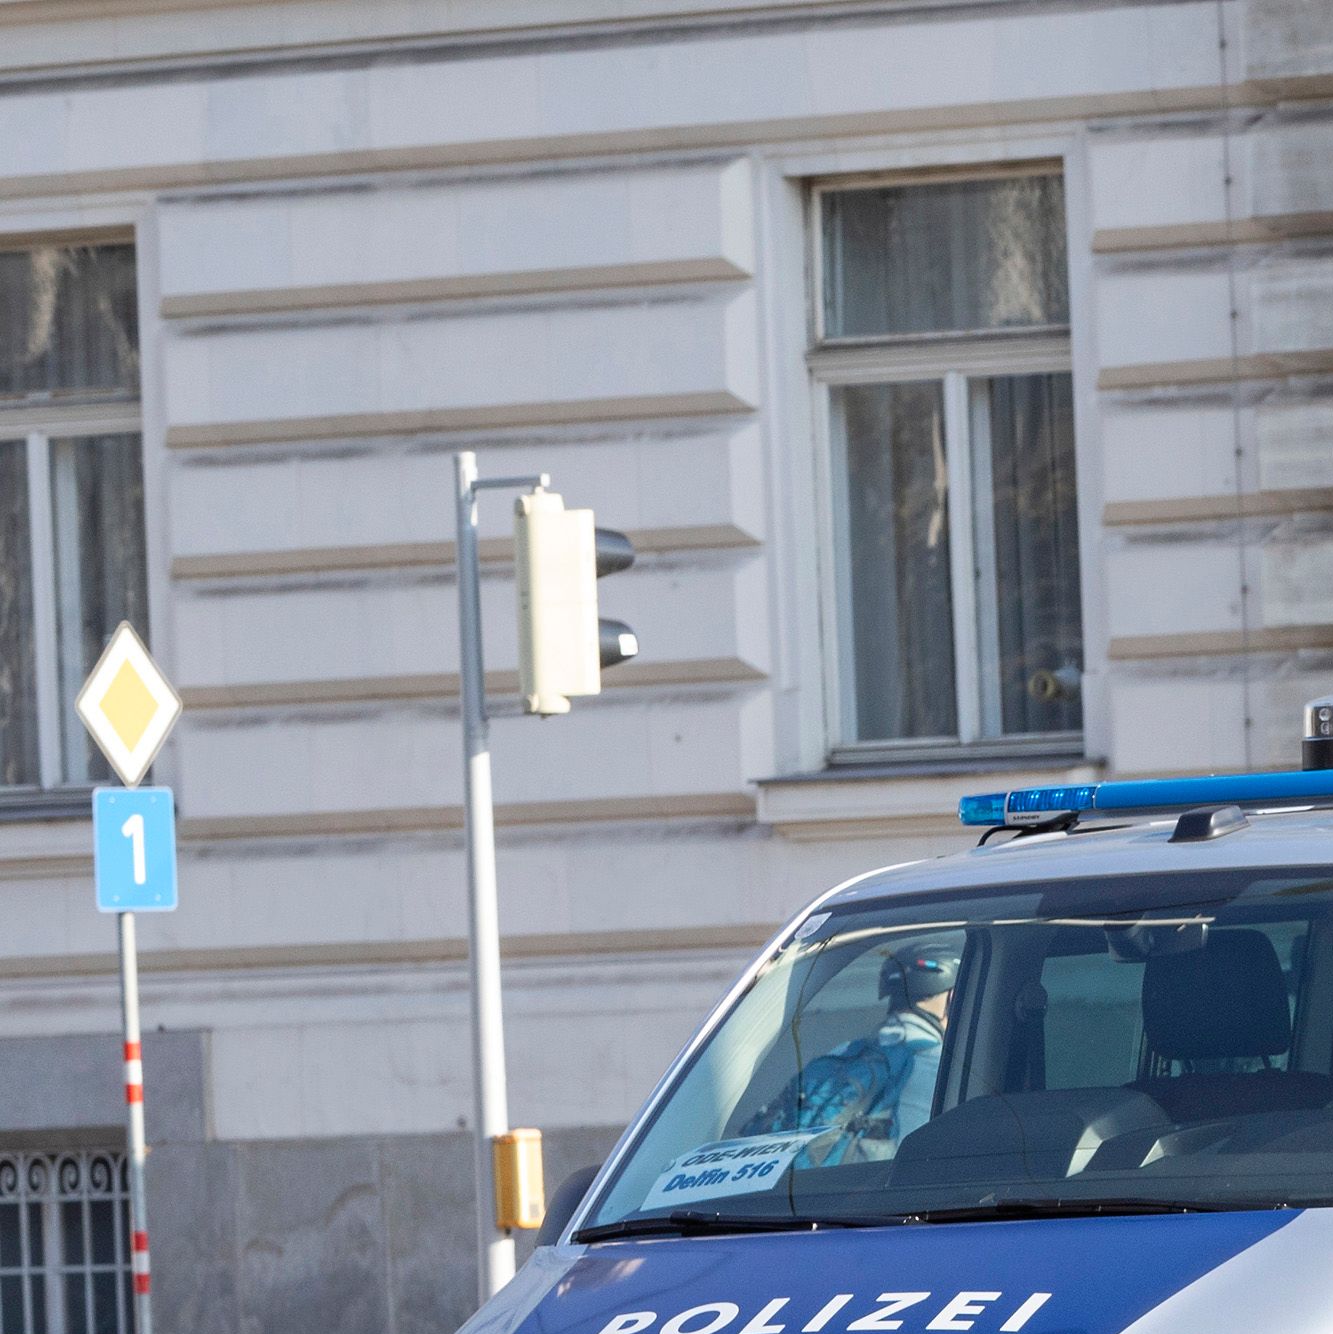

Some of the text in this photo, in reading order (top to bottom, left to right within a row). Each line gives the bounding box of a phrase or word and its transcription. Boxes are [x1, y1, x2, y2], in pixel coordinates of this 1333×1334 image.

[121, 813, 147, 885] 1
[662, 1160, 780, 1193] Delfin 516
